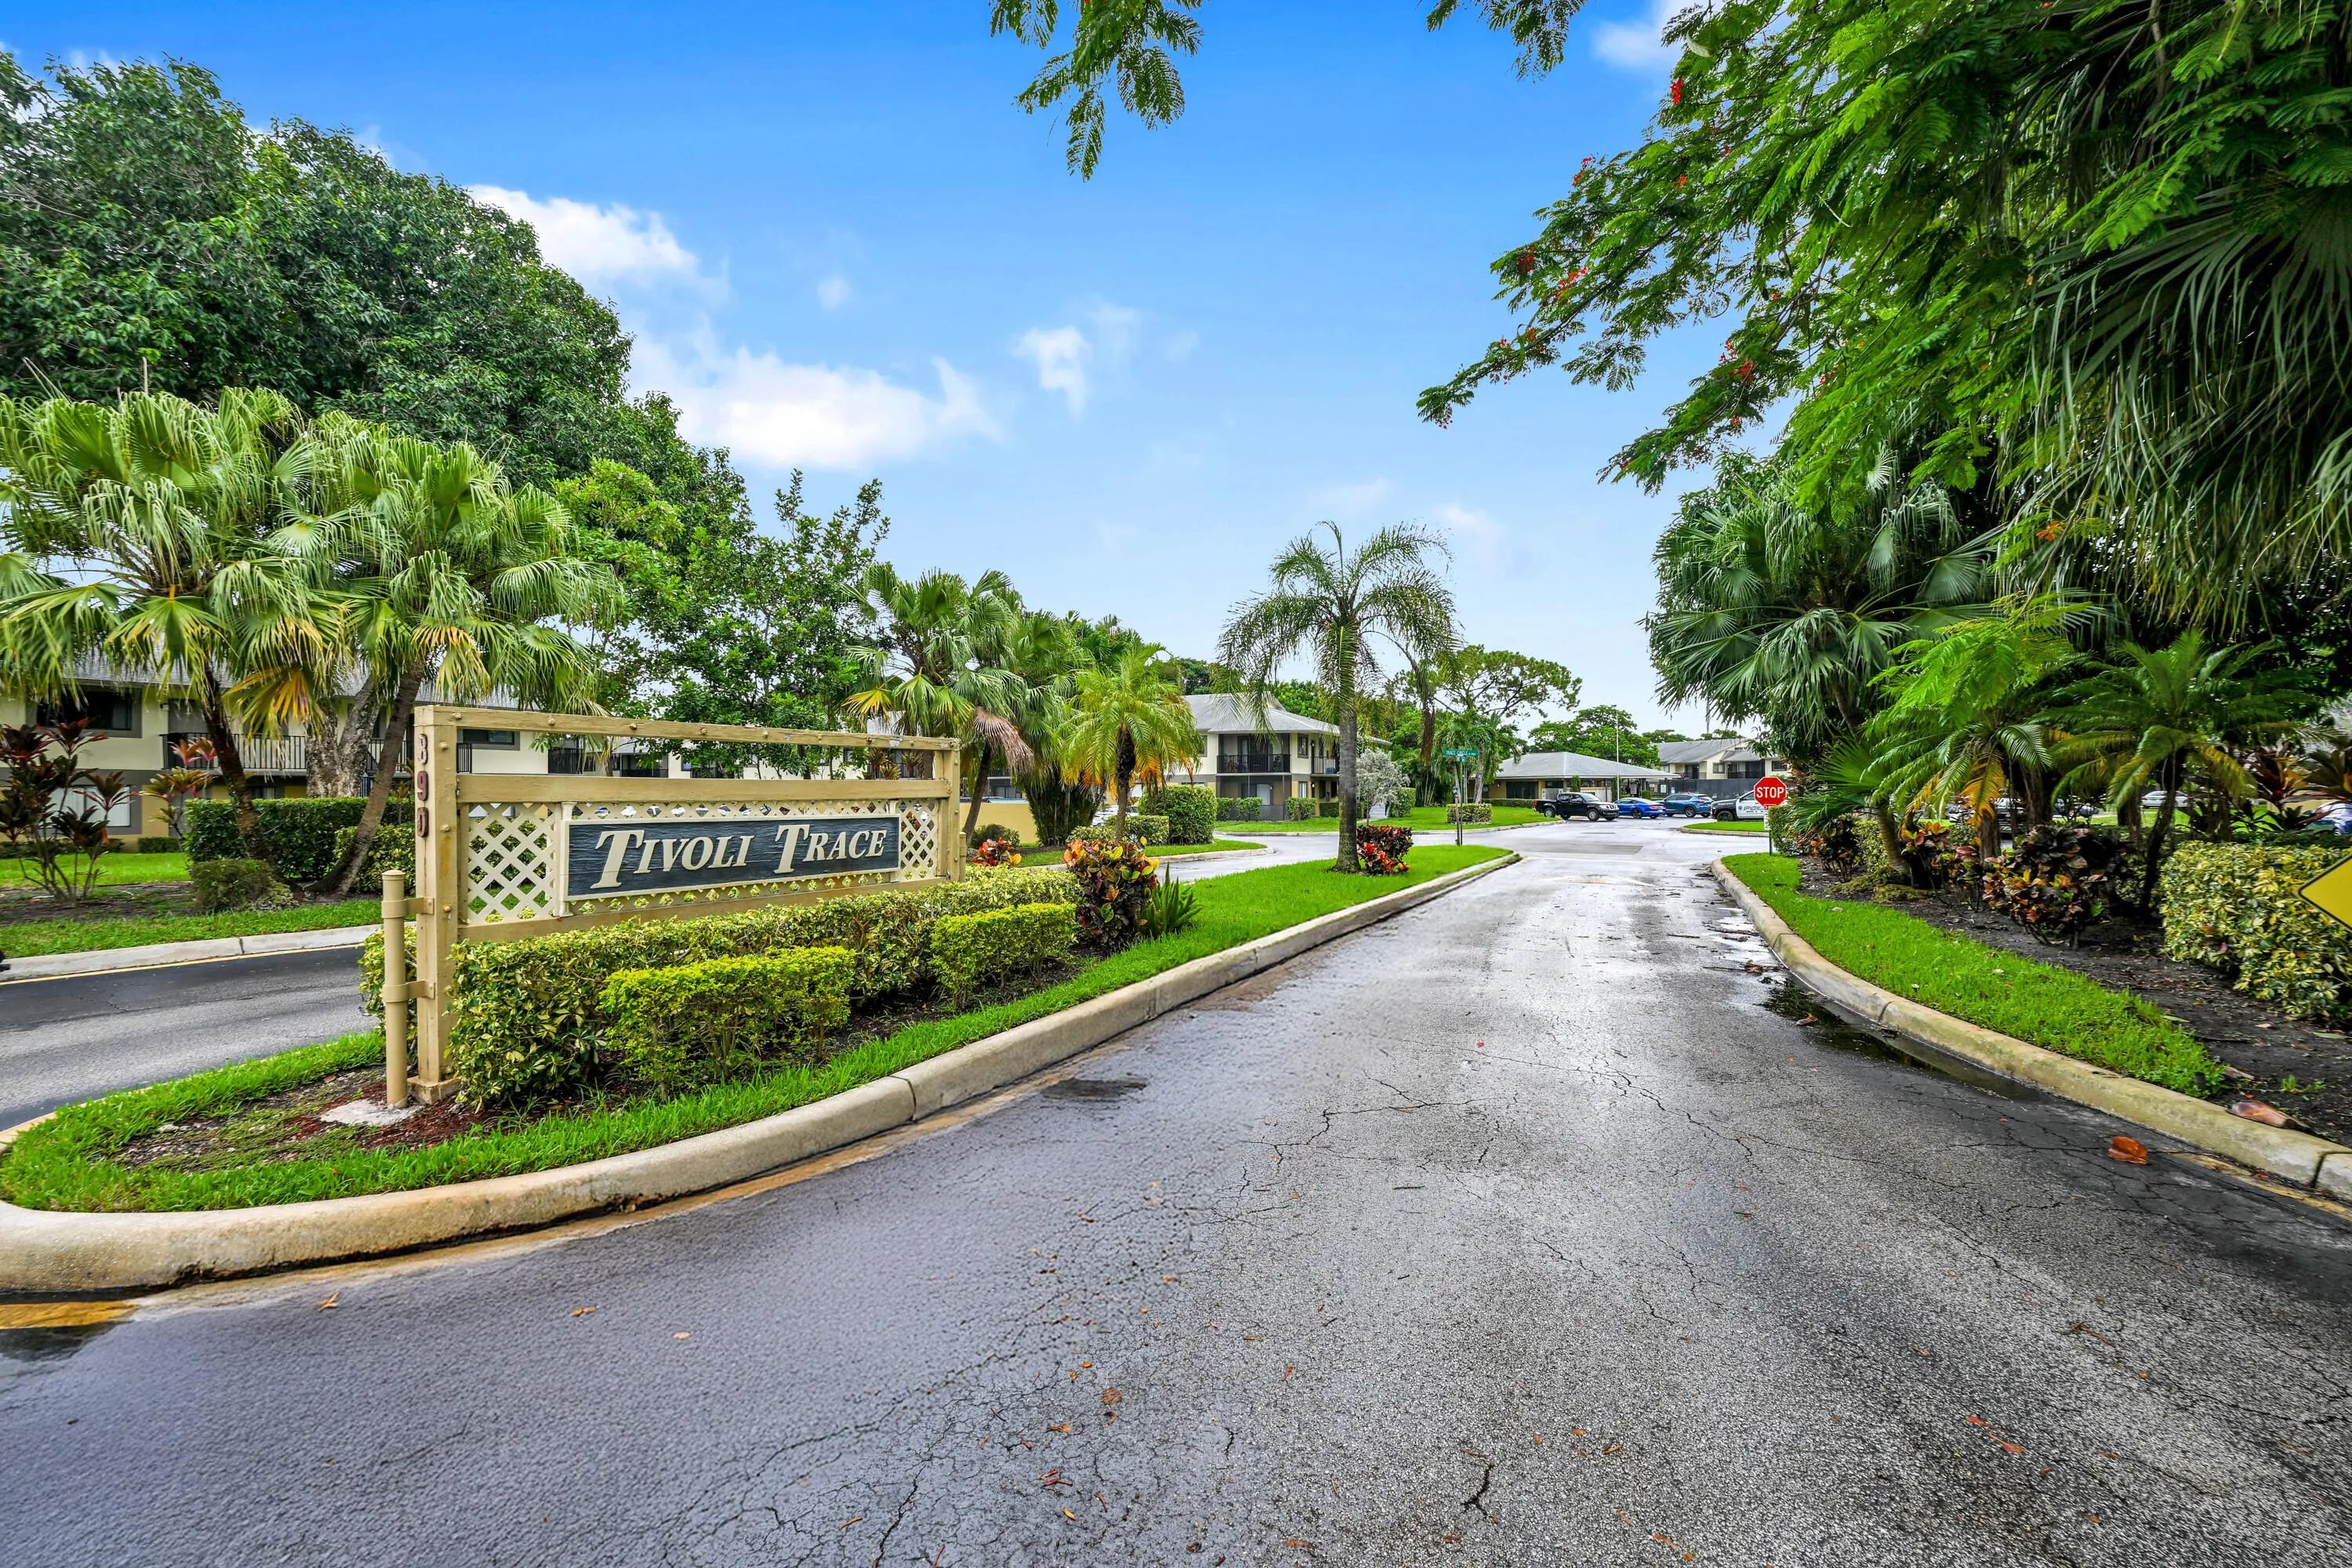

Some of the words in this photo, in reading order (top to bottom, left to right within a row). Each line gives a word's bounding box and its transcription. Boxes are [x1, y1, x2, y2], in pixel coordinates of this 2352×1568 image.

[416, 733, 430, 838] 890
[1756, 786, 1784, 798] STOP
[590, 829, 755, 889] TIVOLI
[773, 824, 887, 874] TRACE
